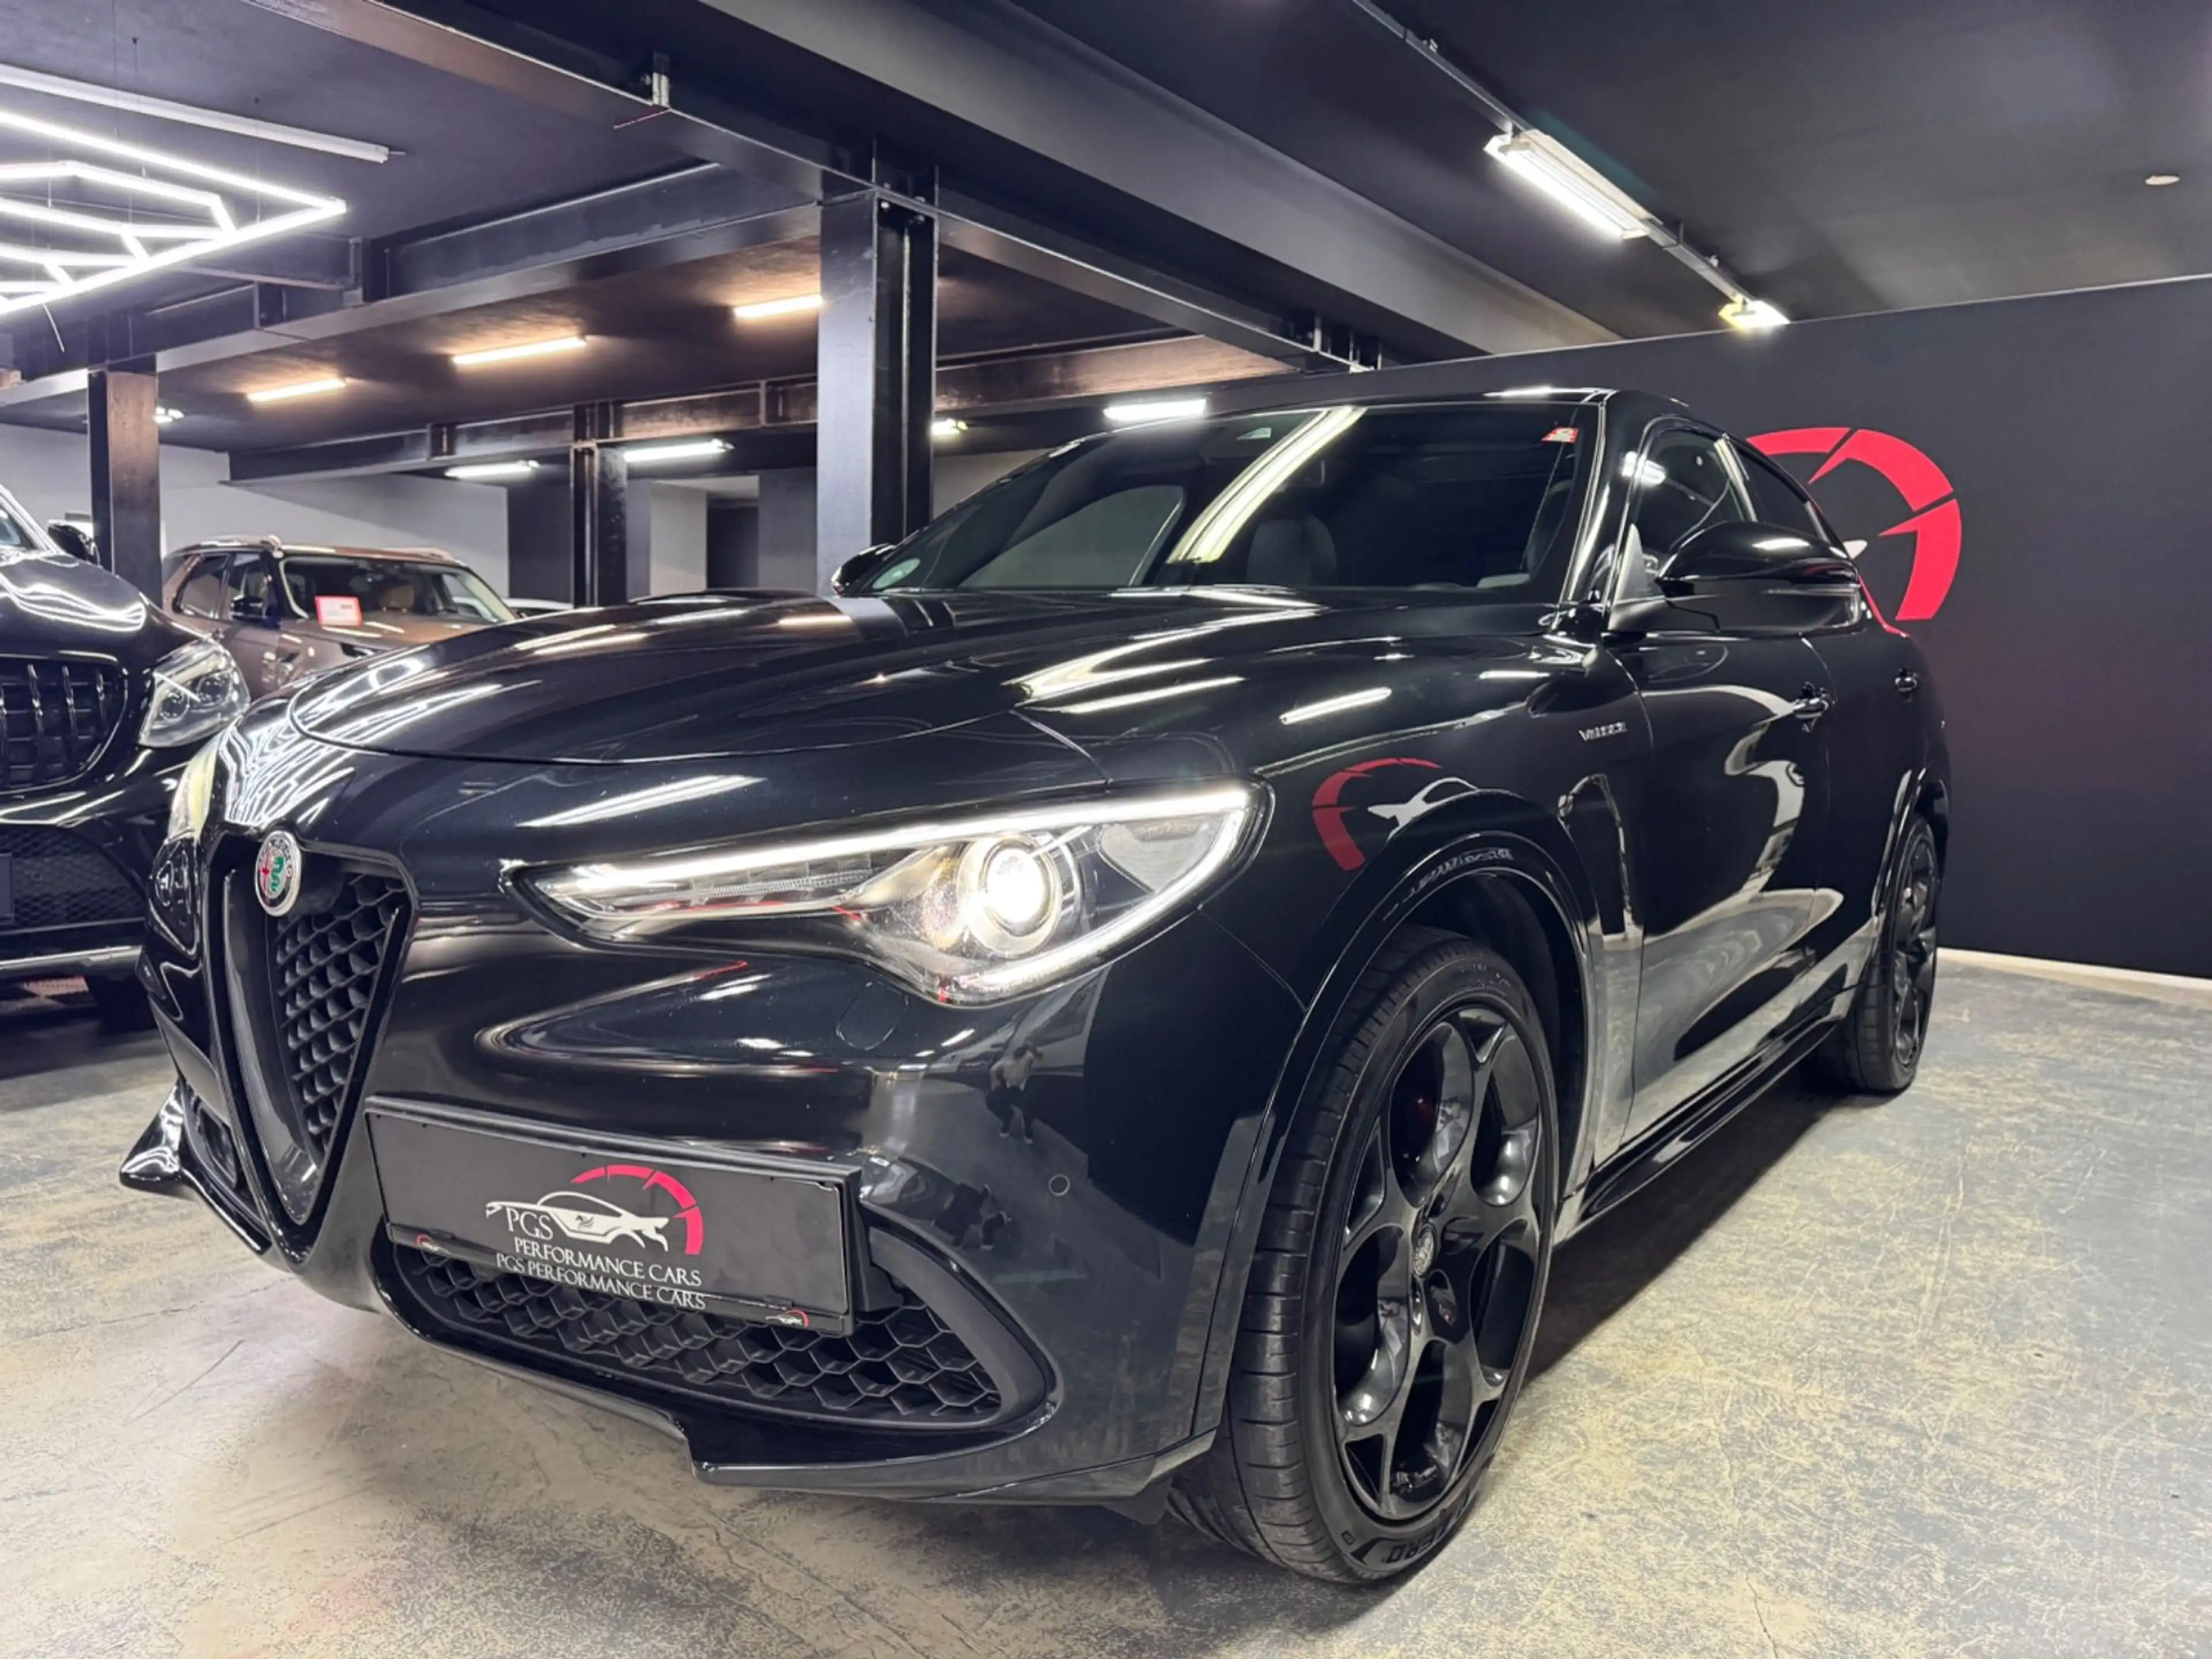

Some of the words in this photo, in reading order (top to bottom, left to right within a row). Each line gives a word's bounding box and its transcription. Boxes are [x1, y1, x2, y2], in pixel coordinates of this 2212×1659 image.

[506, 1207, 554, 1240] PGS
[496, 1252, 525, 1274] PGS
[527, 1260, 653, 1301] PERFORMANCE
[656, 1286, 706, 1309] CARS
[514, 1236, 645, 1279] PERFORMANCE
[649, 1263, 702, 1286] CARS
